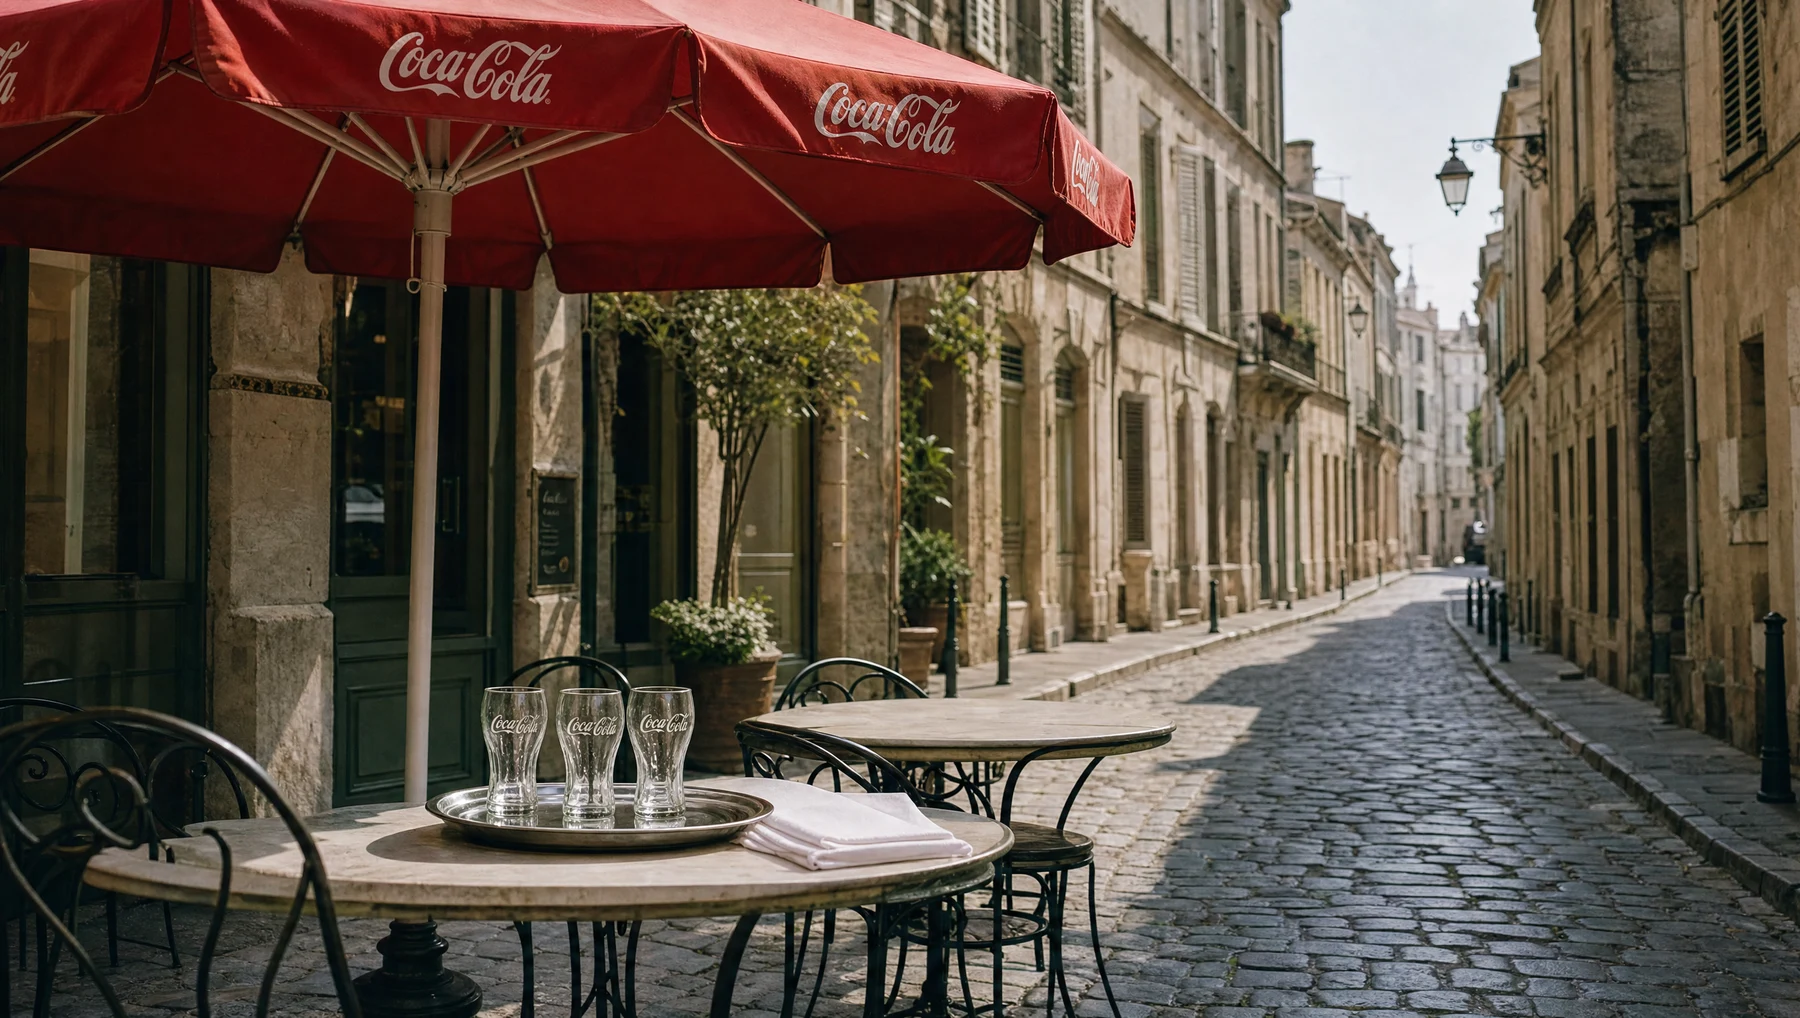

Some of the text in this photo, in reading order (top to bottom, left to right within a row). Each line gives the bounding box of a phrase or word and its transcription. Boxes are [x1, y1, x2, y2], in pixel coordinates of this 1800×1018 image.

[379, 31, 562, 104] Coca-Cola
[814, 82, 961, 155] Coca-Cola
[491, 714, 540, 734] Coca-Cola
[566, 716, 618, 736] Coca-Cola
[639, 713, 690, 733] Coca-Cola
